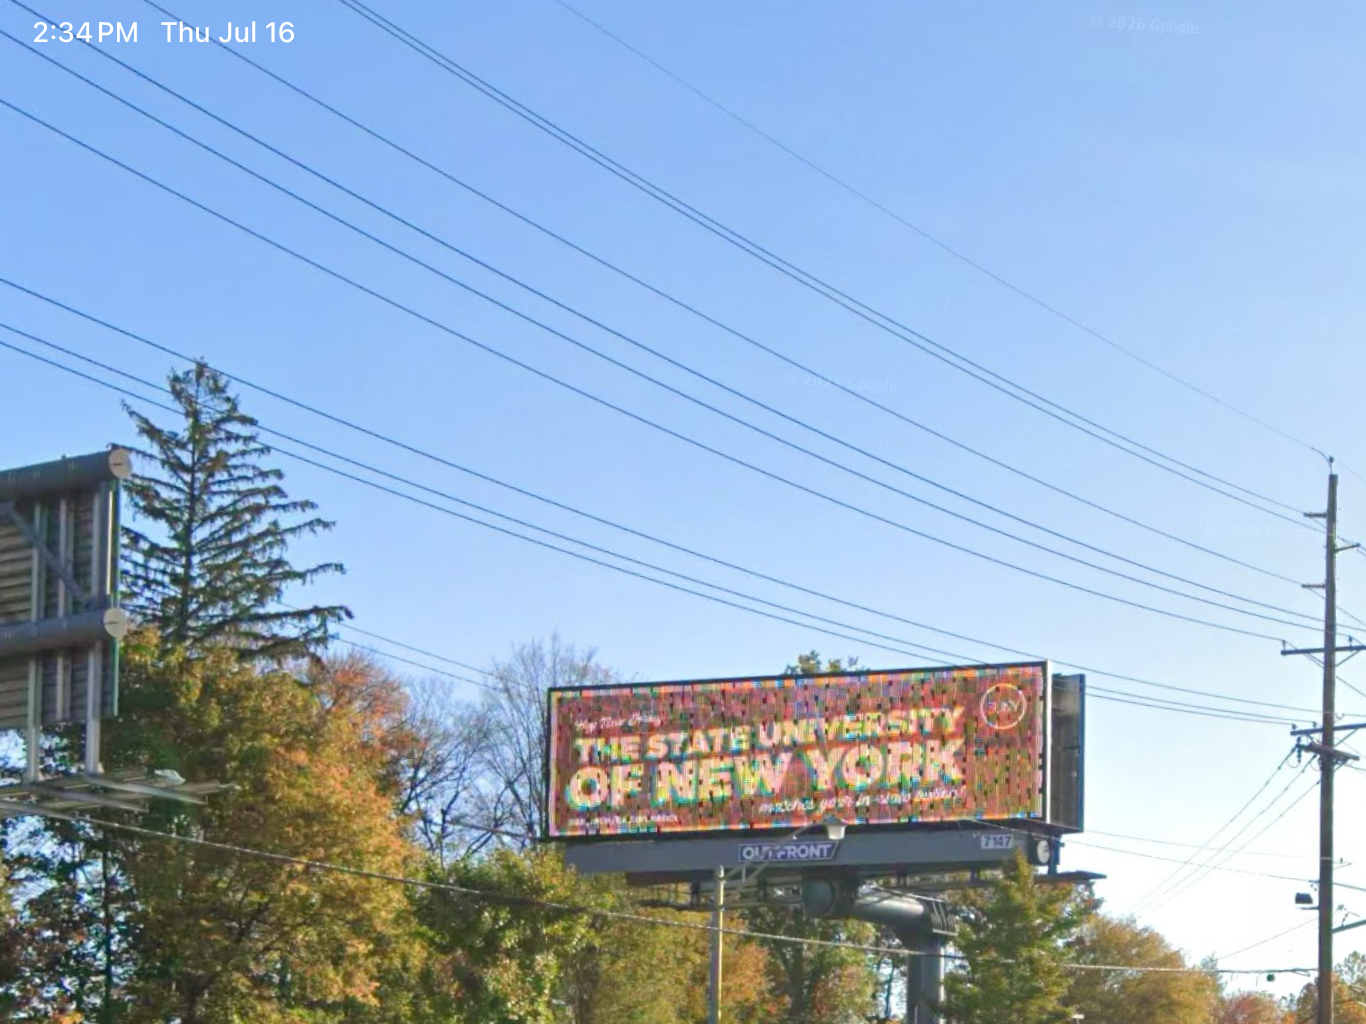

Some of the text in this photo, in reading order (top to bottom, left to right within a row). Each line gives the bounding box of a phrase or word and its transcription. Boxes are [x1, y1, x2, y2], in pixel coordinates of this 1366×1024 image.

[574, 705, 966, 764] THE STATE UNIVERSITY
[566, 738, 965, 810] OF NEW YORK
[742, 843, 832, 860] OUTFRONT
